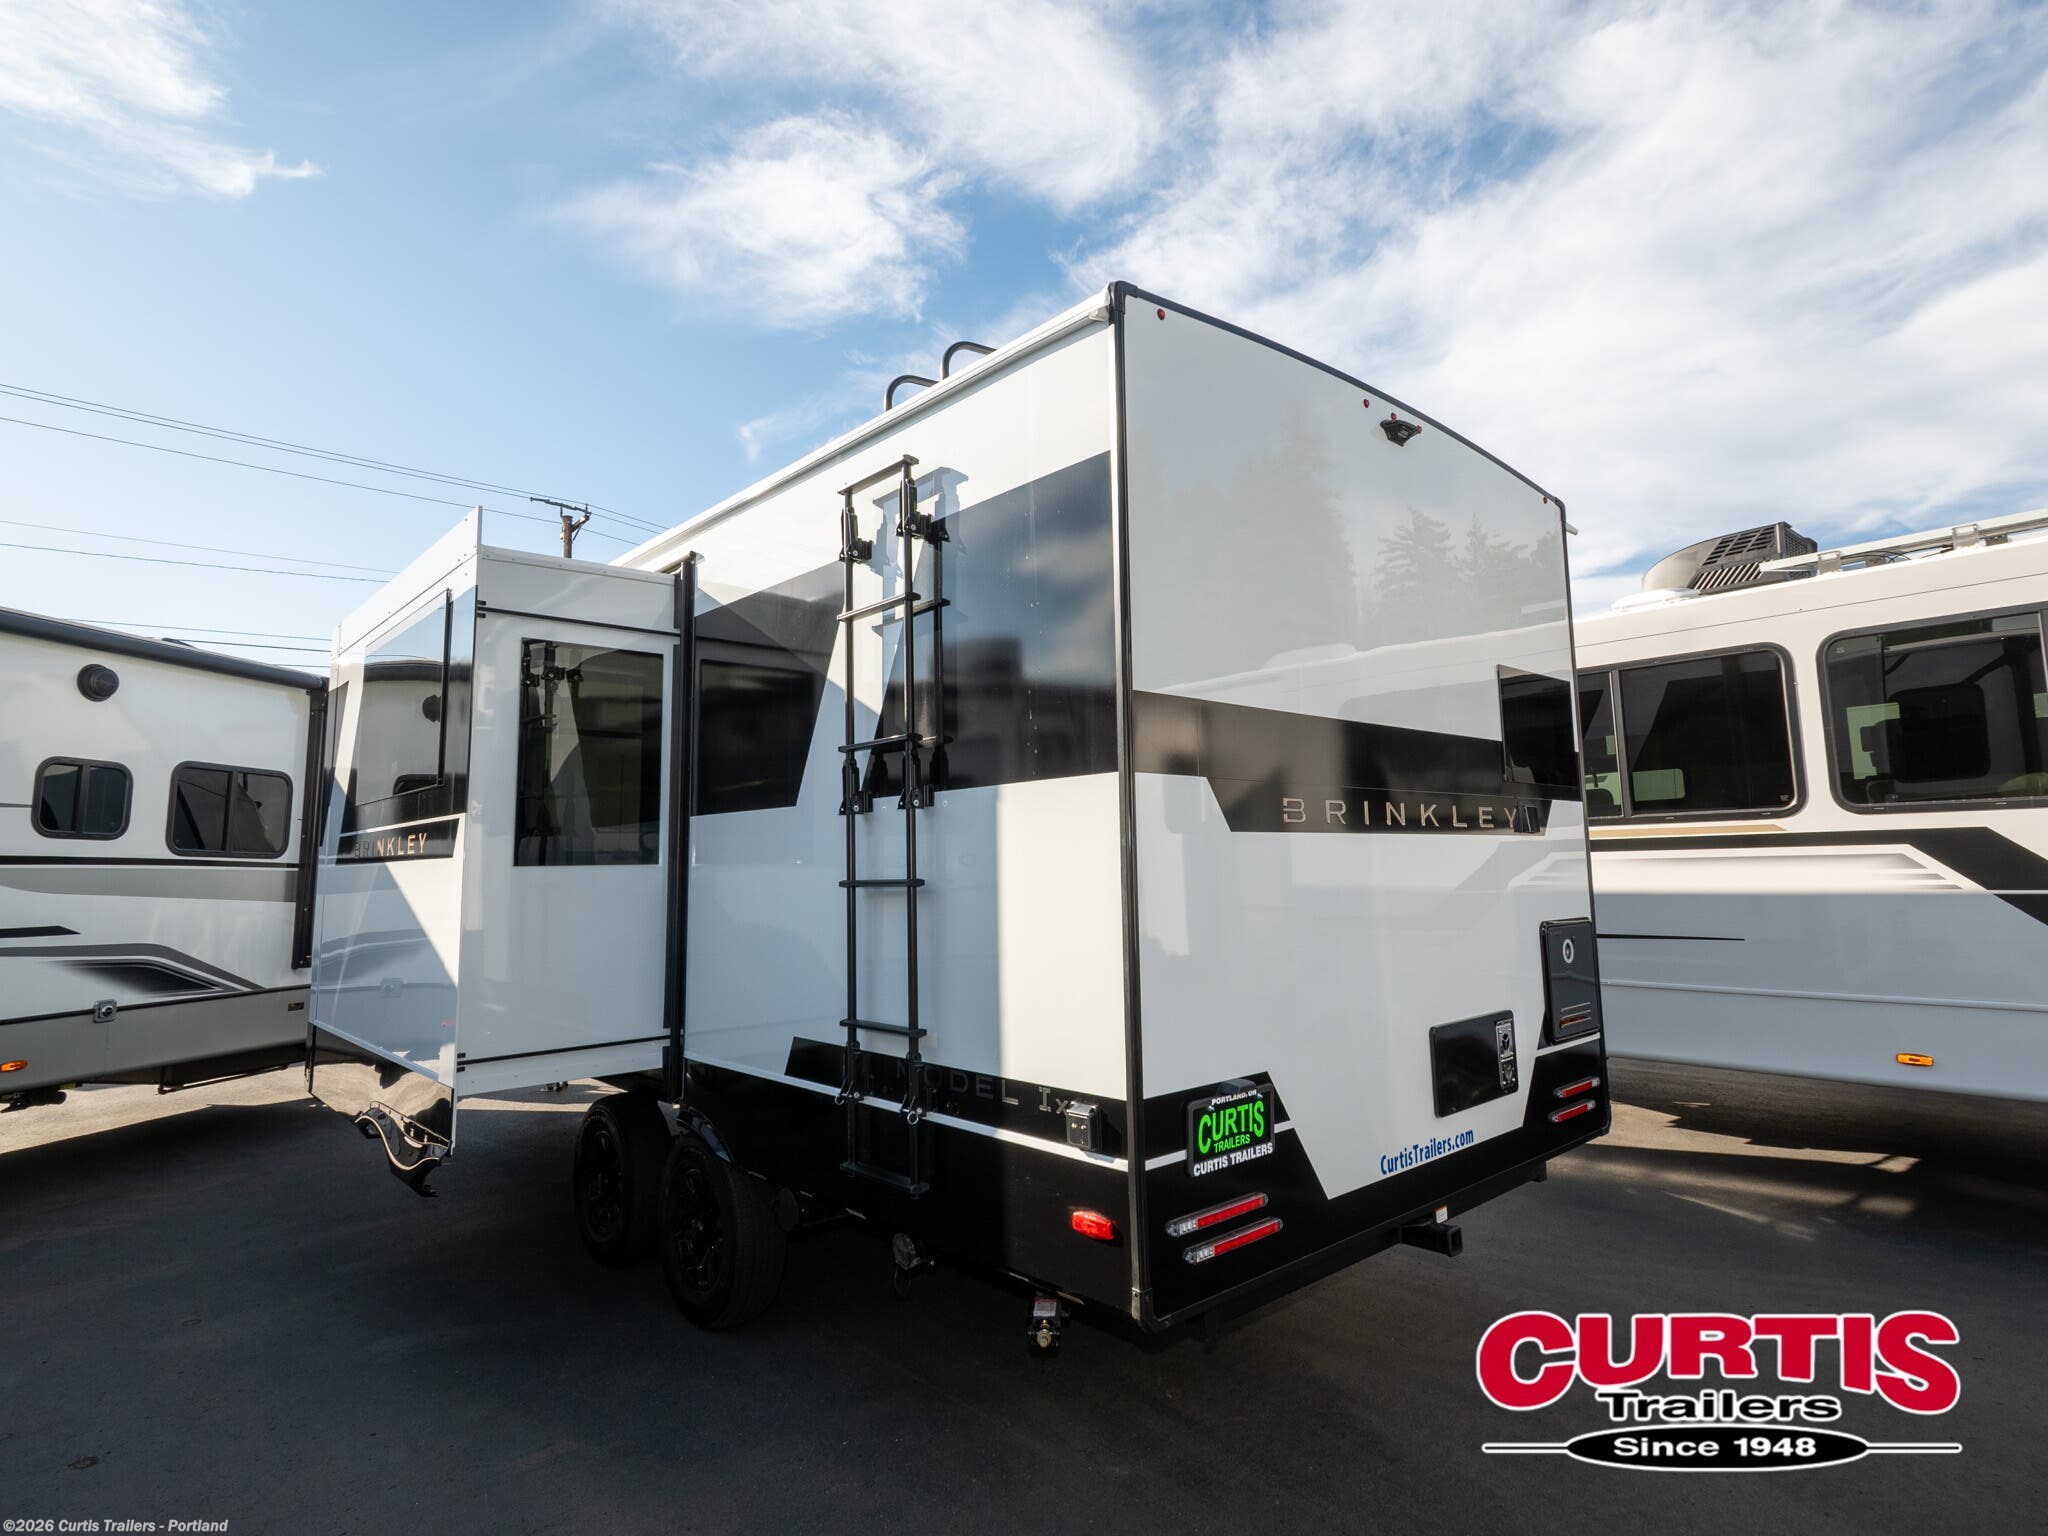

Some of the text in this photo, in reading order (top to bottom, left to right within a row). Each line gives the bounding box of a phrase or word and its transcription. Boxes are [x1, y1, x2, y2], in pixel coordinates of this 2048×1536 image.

[1282, 797, 1518, 828] BRINKLEY
[353, 832, 428, 860] BRINKLEY
[1198, 1100, 1264, 1154] CURTIS
[1214, 1134, 1251, 1153] TRAILERS
[1193, 1142, 1273, 1177] CURTIS TRAILERS
[1380, 1129, 1474, 1175] CurtisTrailers.com
